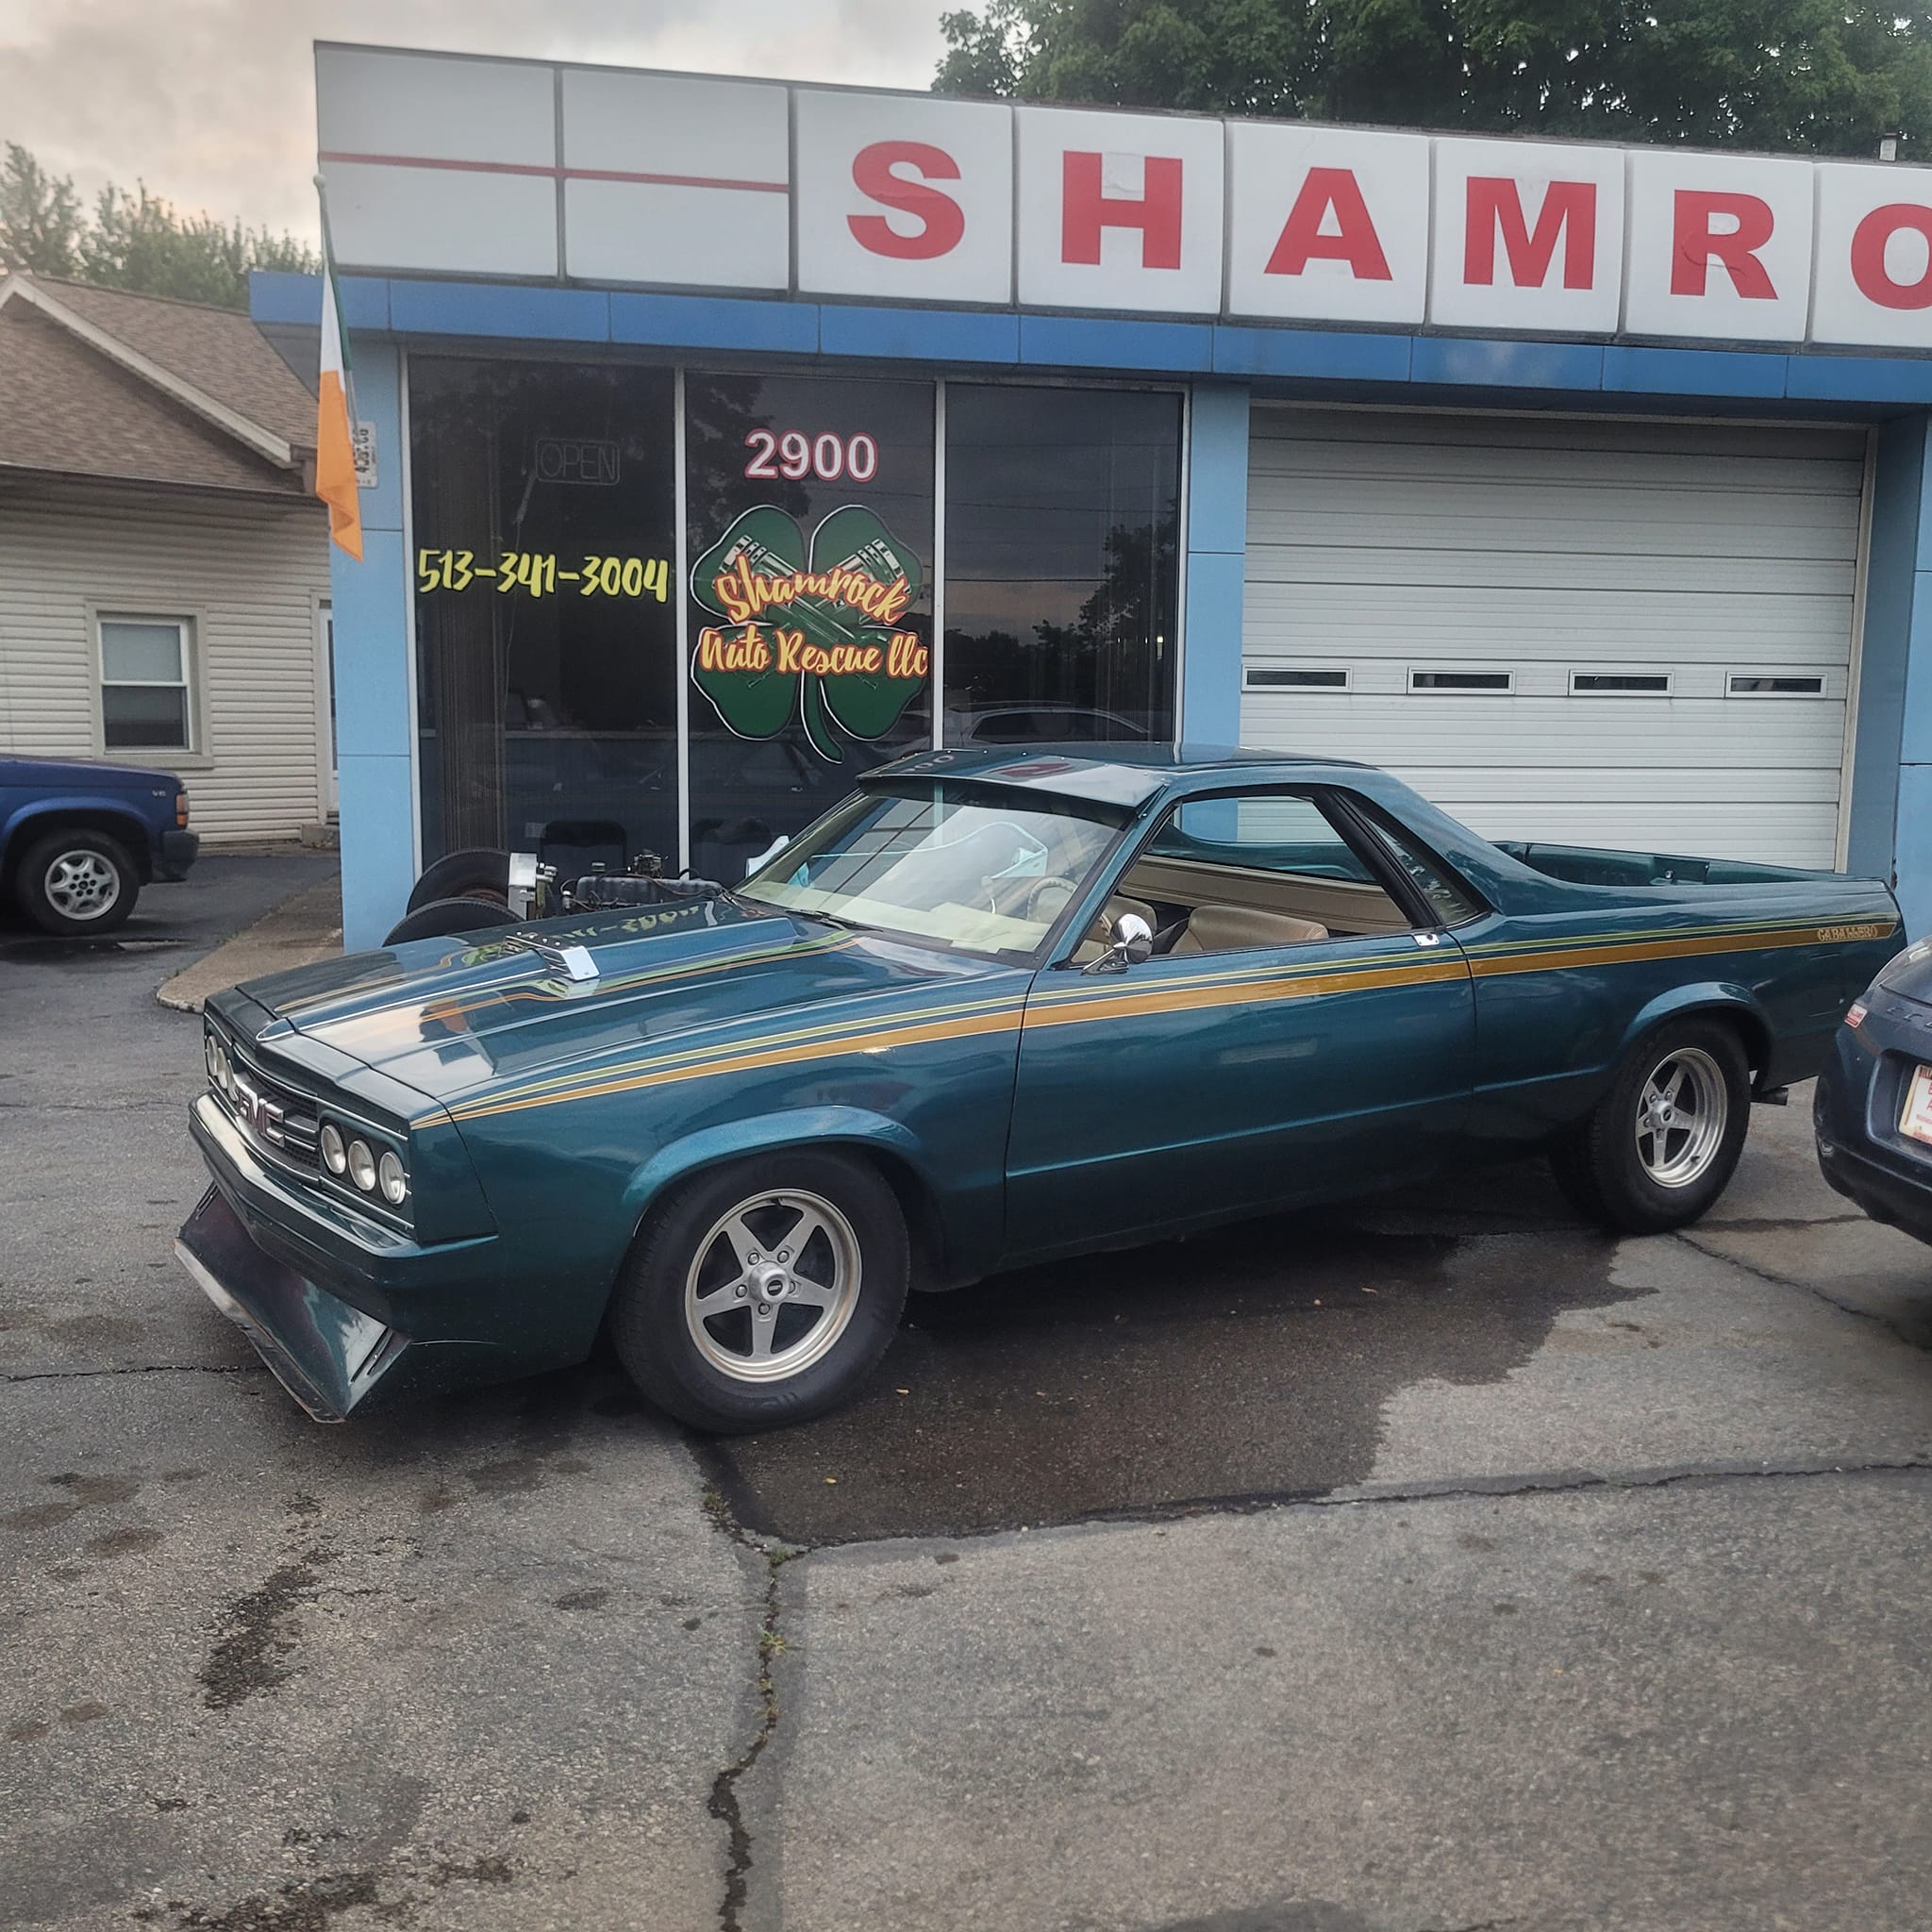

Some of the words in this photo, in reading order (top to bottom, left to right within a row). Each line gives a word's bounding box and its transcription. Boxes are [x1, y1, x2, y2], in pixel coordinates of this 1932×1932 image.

[846, 140, 1932, 311] SHAMRO
[540, 443, 617, 481] OPEN
[744, 428, 878, 483] 2900
[418, 548, 669, 604] 513-341-3004
[714, 551, 910, 625] Shamrock
[699, 623, 770, 672] Auto
[774, 627, 883, 676] Rescue
[1818, 925, 1878, 941] CABALLERO
